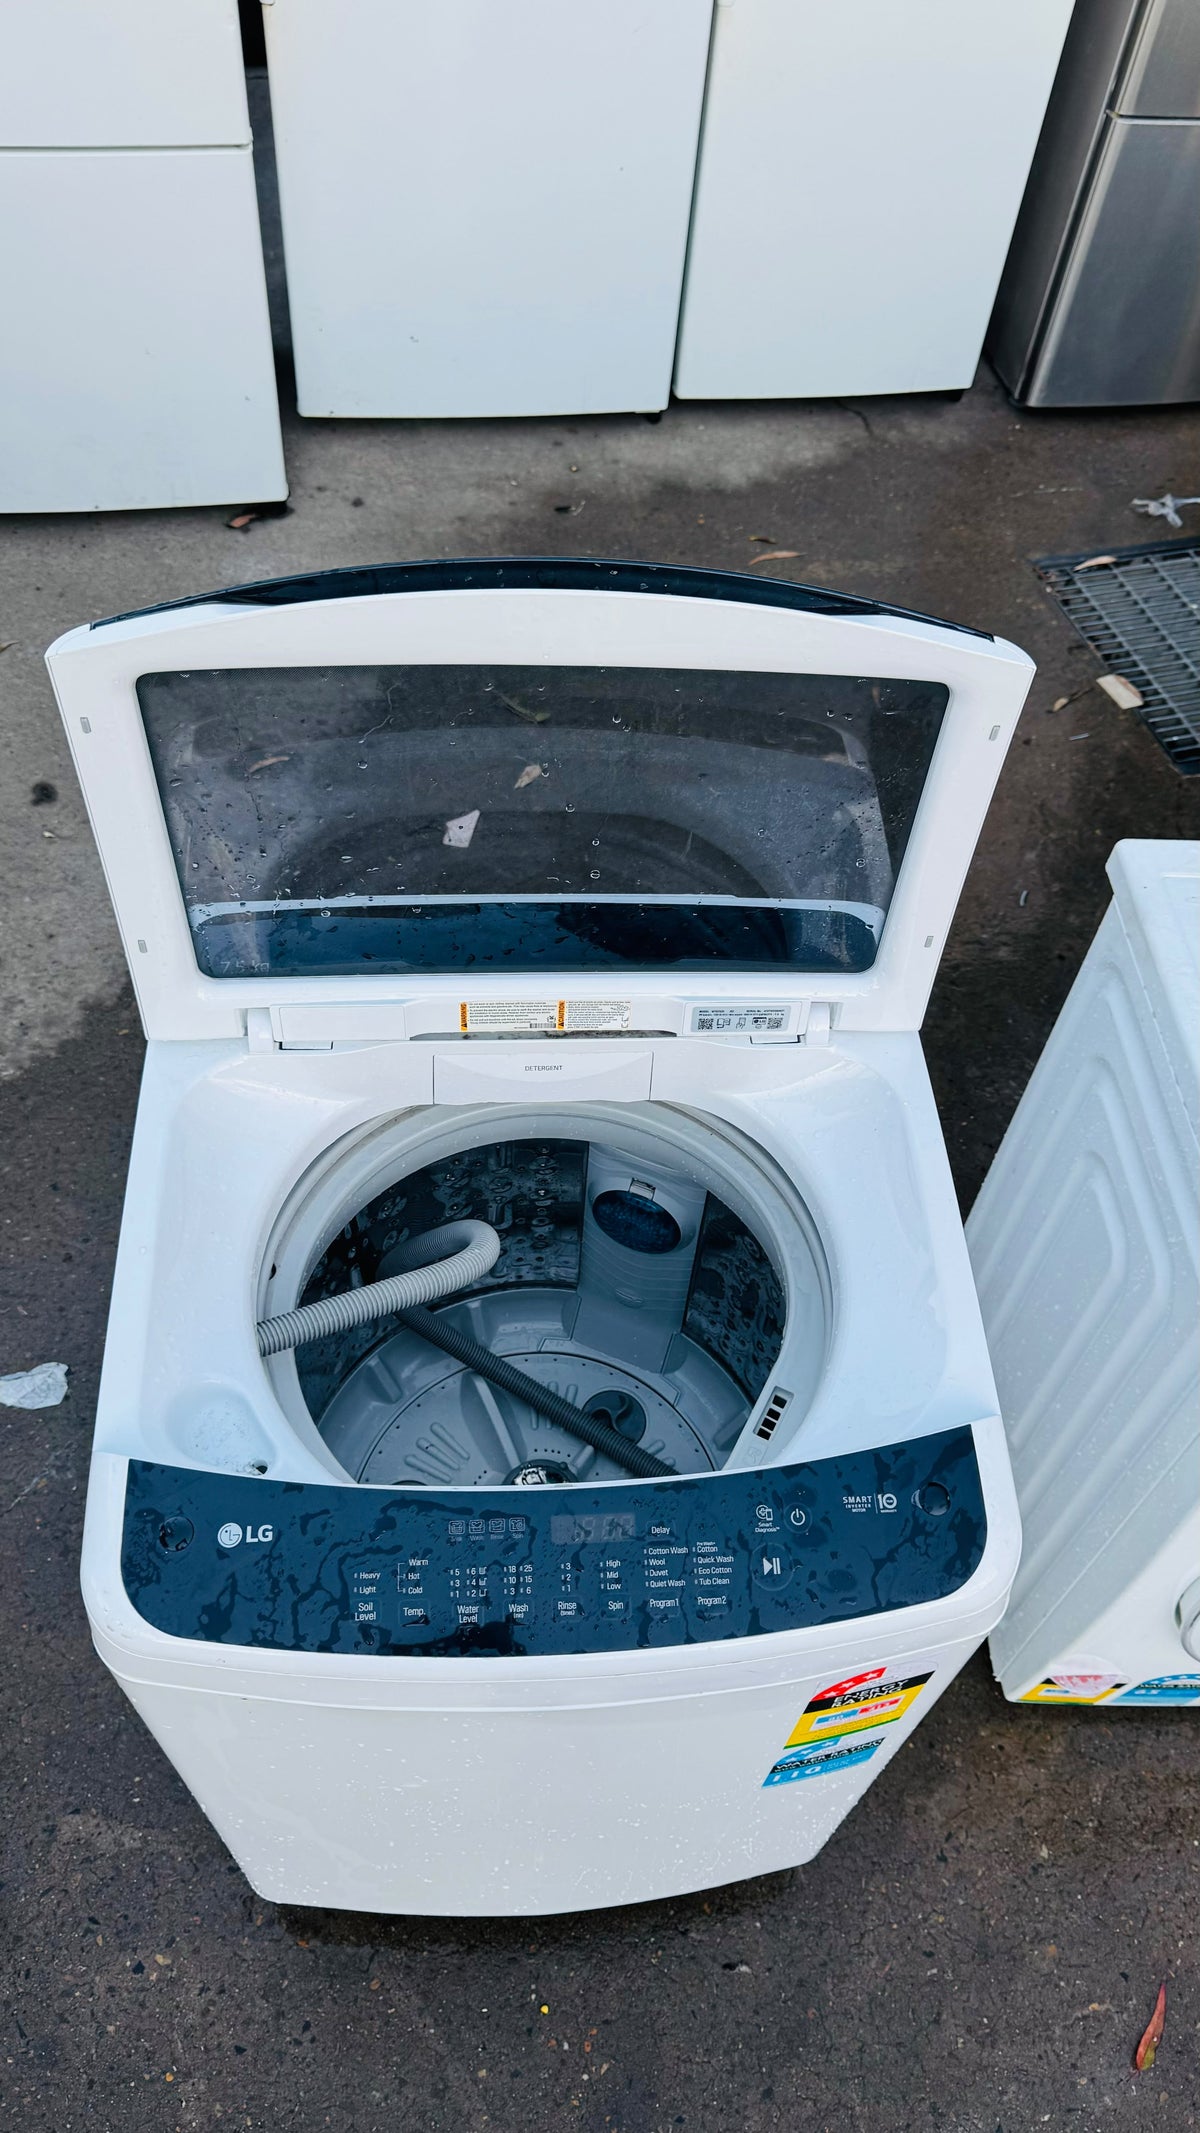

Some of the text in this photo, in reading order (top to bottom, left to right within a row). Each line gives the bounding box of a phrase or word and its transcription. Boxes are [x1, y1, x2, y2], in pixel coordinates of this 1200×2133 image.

[842, 1493, 897, 1509] SMART 10
[246, 1524, 273, 1543] LG
[651, 1526, 670, 1535] Delay
[648, 1546, 688, 1555] Cotton Wash
[649, 1558, 665, 1566] Wool
[716, 1555, 734, 1563] Wash
[606, 1560, 620, 1568] High
[359, 1572, 381, 1580] Heavy
[607, 1571, 619, 1579] Mid
[650, 1579, 685, 1588] Quiet Wash
[359, 1586, 376, 1594] Light
[358, 1602, 373, 1611] Soil
[457, 1605, 479, 1614] Water
[508, 1604, 529, 1613] Wash
[558, 1601, 577, 1610] Rinse
[608, 1601, 624, 1610] Spin
[355, 1612, 376, 1621] Level
[403, 1608, 426, 1616] Temp.
[459, 1615, 478, 1623] Level
[834, 1680, 909, 1703] ENERGY
[831, 1687, 902, 1708] RATING
